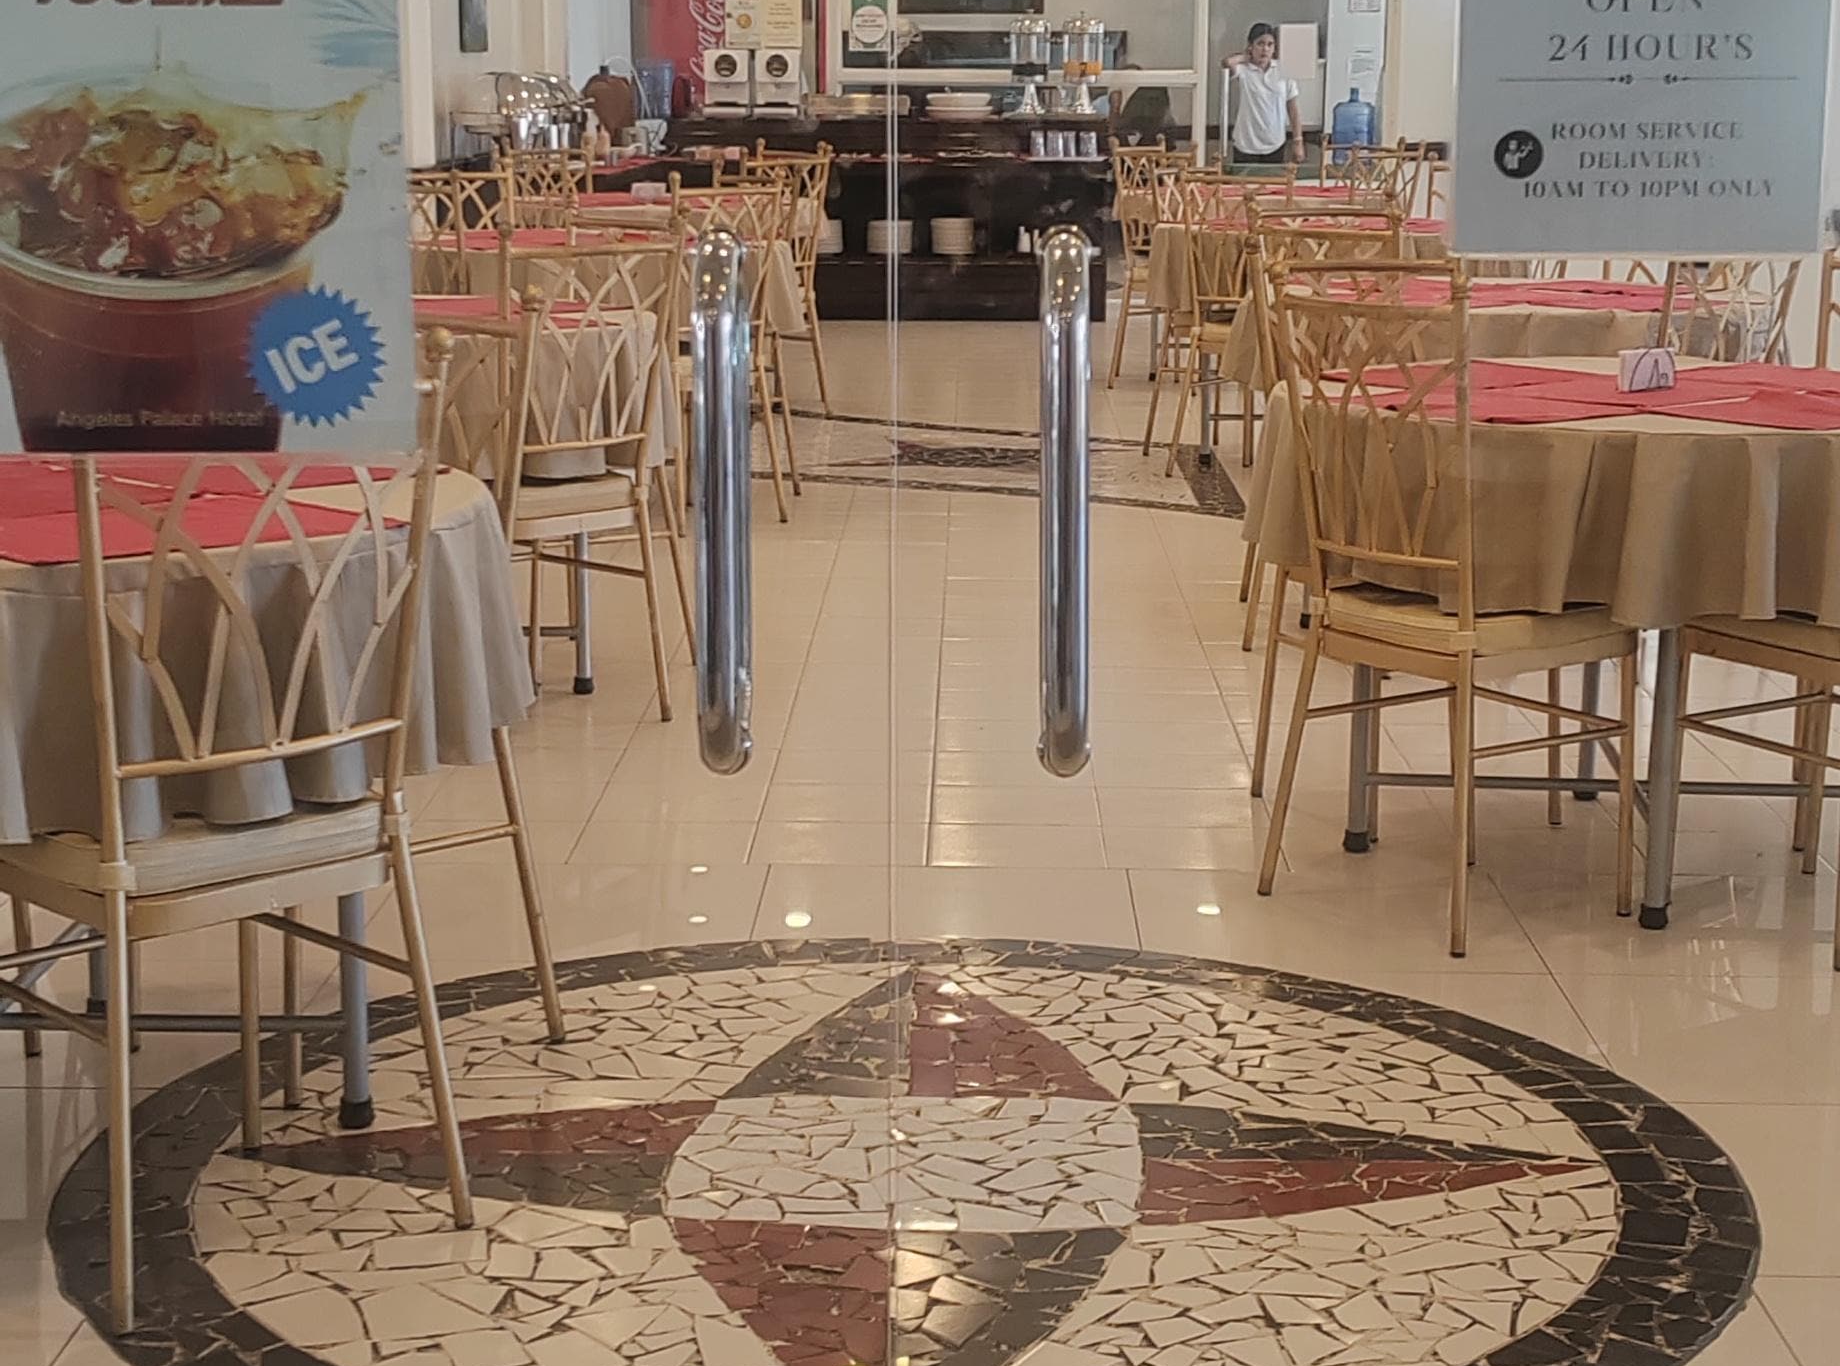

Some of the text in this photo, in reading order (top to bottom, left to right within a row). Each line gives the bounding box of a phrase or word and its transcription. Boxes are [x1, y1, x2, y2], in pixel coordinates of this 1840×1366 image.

[1549, 34, 1753, 62] 24 HOUR'S
[1551, 121, 1743, 141] ROOM SERVICE
[1524, 179, 1776, 199] 10AM TO 10PM ONLY
[263, 318, 360, 395] ICE
[57, 410, 265, 430] Angeles Palace Hotel
